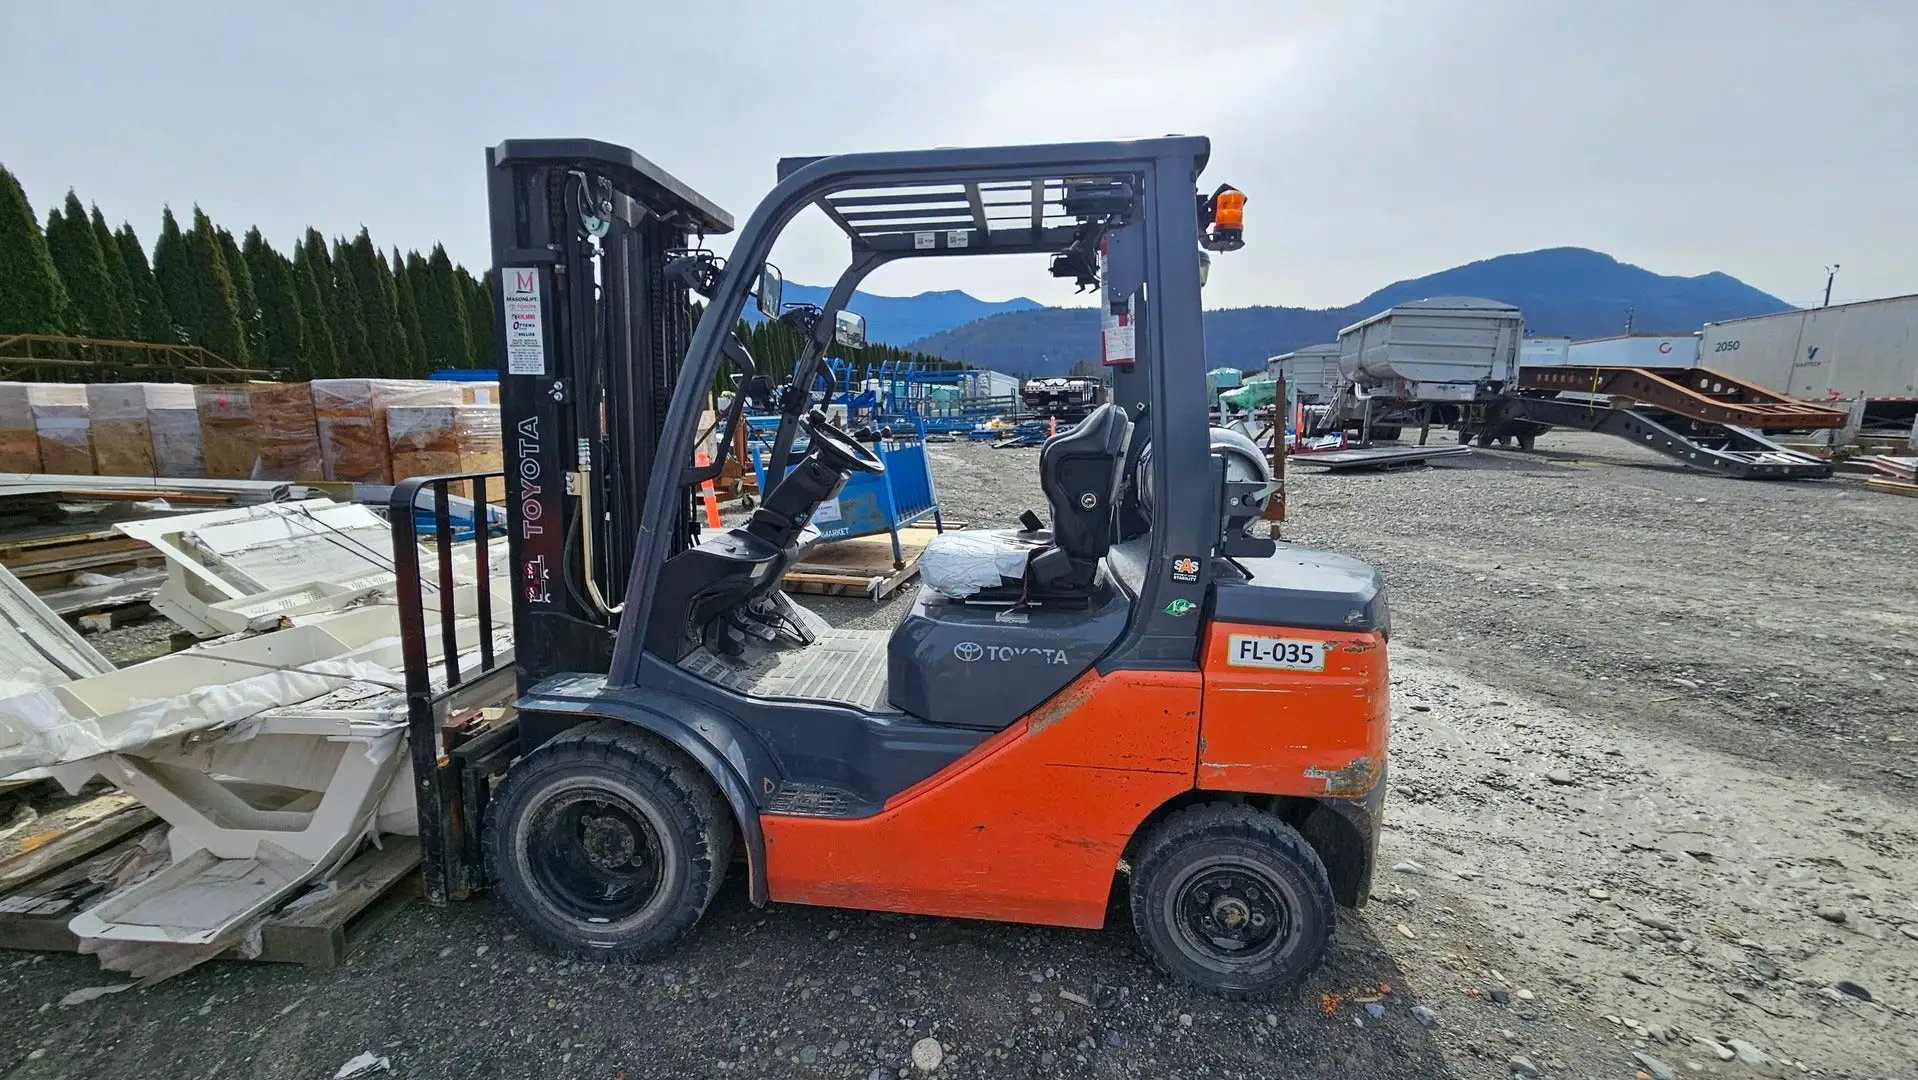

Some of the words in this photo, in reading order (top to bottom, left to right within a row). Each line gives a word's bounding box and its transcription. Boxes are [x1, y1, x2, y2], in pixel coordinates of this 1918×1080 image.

[1715, 340, 1741, 352] 2050
[518, 416, 543, 540] TOYOTA
[1173, 558, 1200, 574] SAS
[1240, 640, 1314, 664] FL-035
